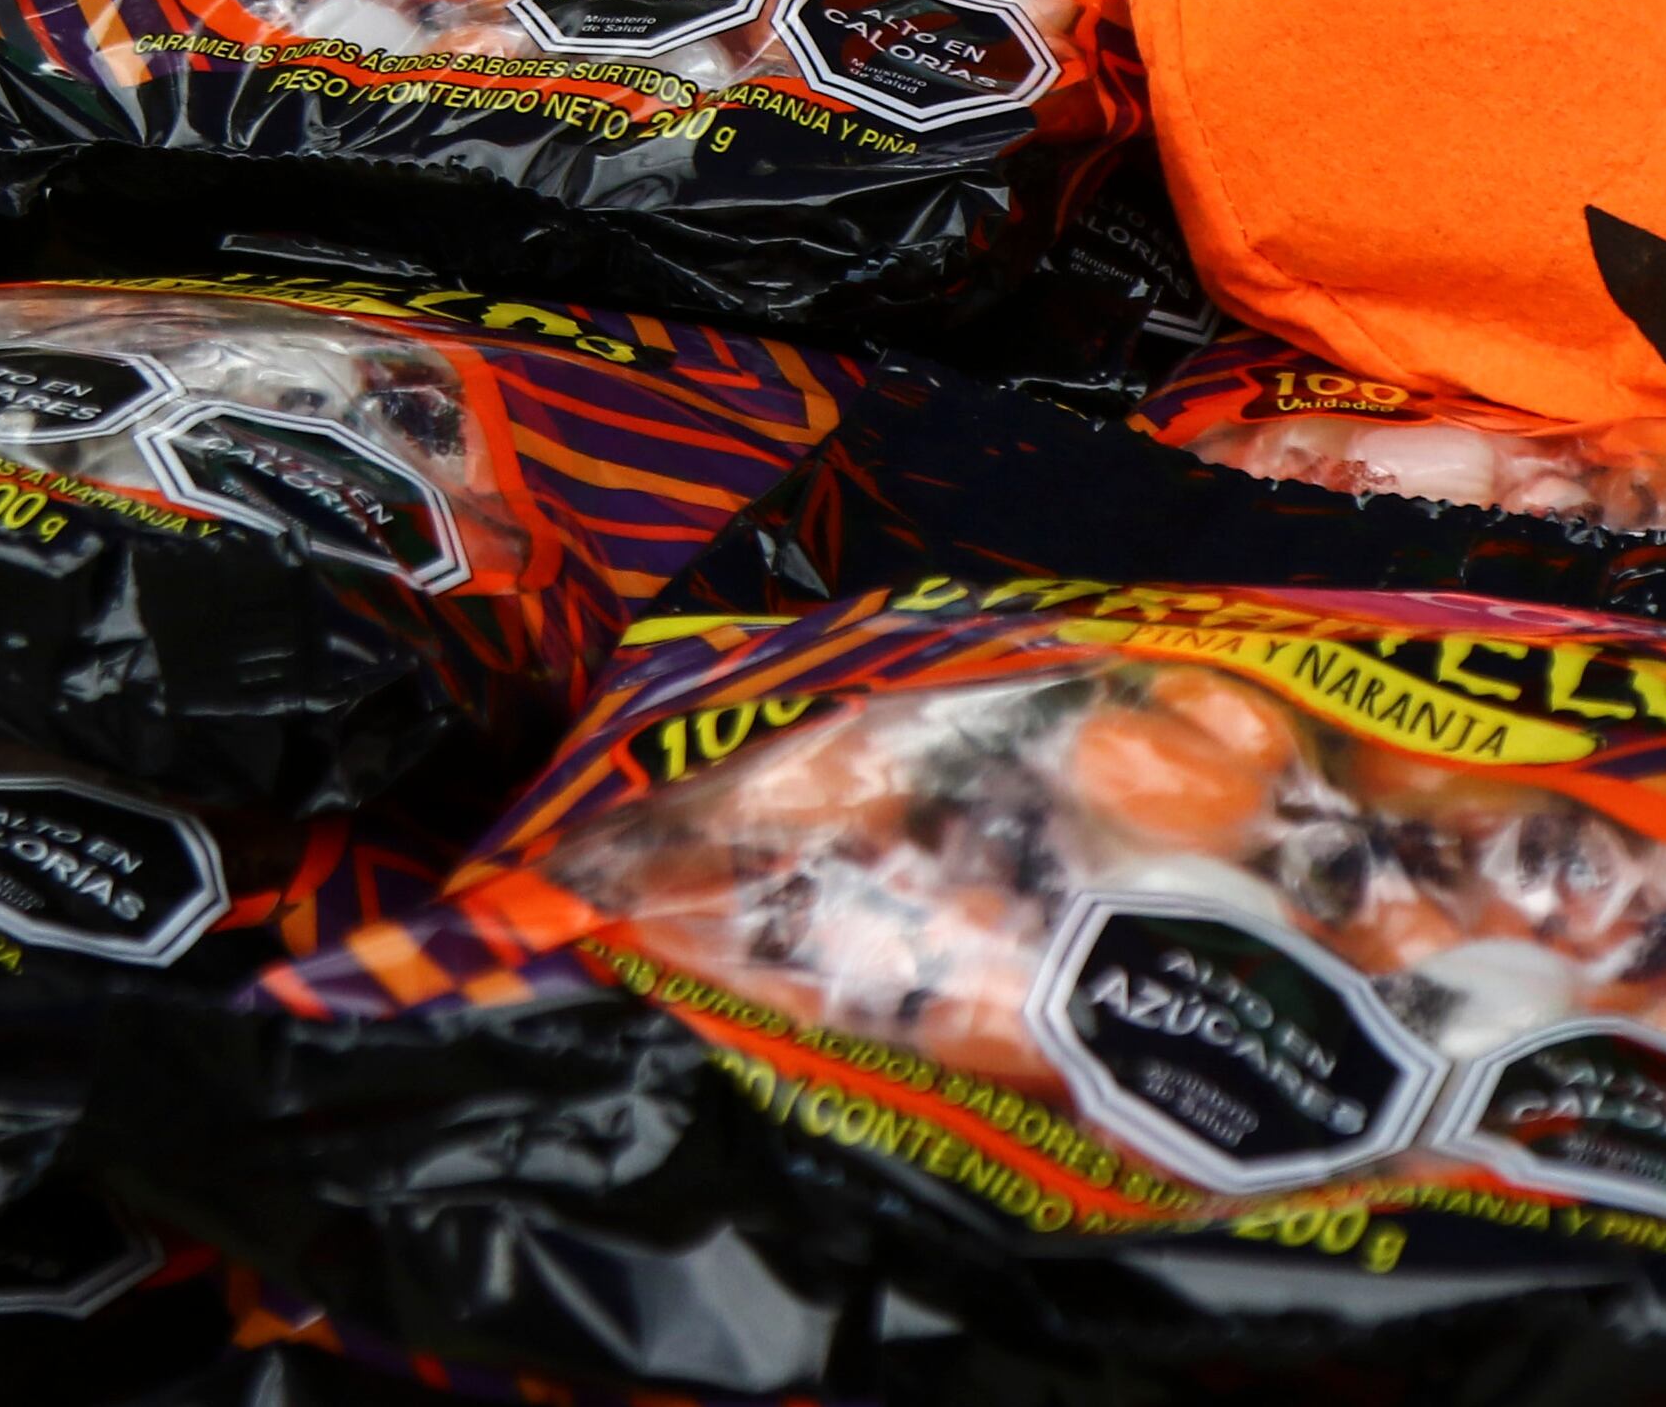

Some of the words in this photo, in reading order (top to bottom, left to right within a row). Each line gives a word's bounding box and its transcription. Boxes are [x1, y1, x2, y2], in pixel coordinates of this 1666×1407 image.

[582, 24, 601, 33] de
[604, 23, 648, 34] Salud
[583, 14, 656, 25] Ministerio
[862, 8, 937, 44] ALTO
[944, 39, 987, 64] EN
[823, 8, 999, 89] CALORÍAS
[134, 33, 279, 66] CARAMELOS
[280, 38, 360, 62] DUROS
[360, 47, 448, 73] ÁCIDOS
[449, 52, 571, 80] SABORES
[572, 59, 698, 108] SURTIDOS
[720, 84, 834, 136] NARANJA
[840, 118, 858, 141] Y
[849, 67, 871, 80] de
[873, 74, 919, 95] Salud
[851, 57, 928, 88] Ministerio
[270, 66, 348, 98] PESO
[366, 80, 540, 113] CONTENIDO
[543, 95, 631, 141] NETO
[639, 106, 718, 143] 200
[711, 124, 737, 153] g
[41, 379, 94, 398] EN
[1275, 371, 1410, 405] 100
[1277, 397, 1396, 413] Unidades
[22, 467, 46, 485] A
[48, 474, 192, 535] NARANJA
[197, 522, 223, 539] Y
[349, 488, 395, 526] EN
[40, 516, 69, 544] g
[1263, 640, 1291, 665] Y
[1293, 644, 1511, 759] NARANJA
[85, 839, 144, 875] EN
[798, 1082, 1076, 1234] CONTENIDO
[1235, 1204, 1372, 1256] 200
[1362, 1222, 1409, 1275] g
